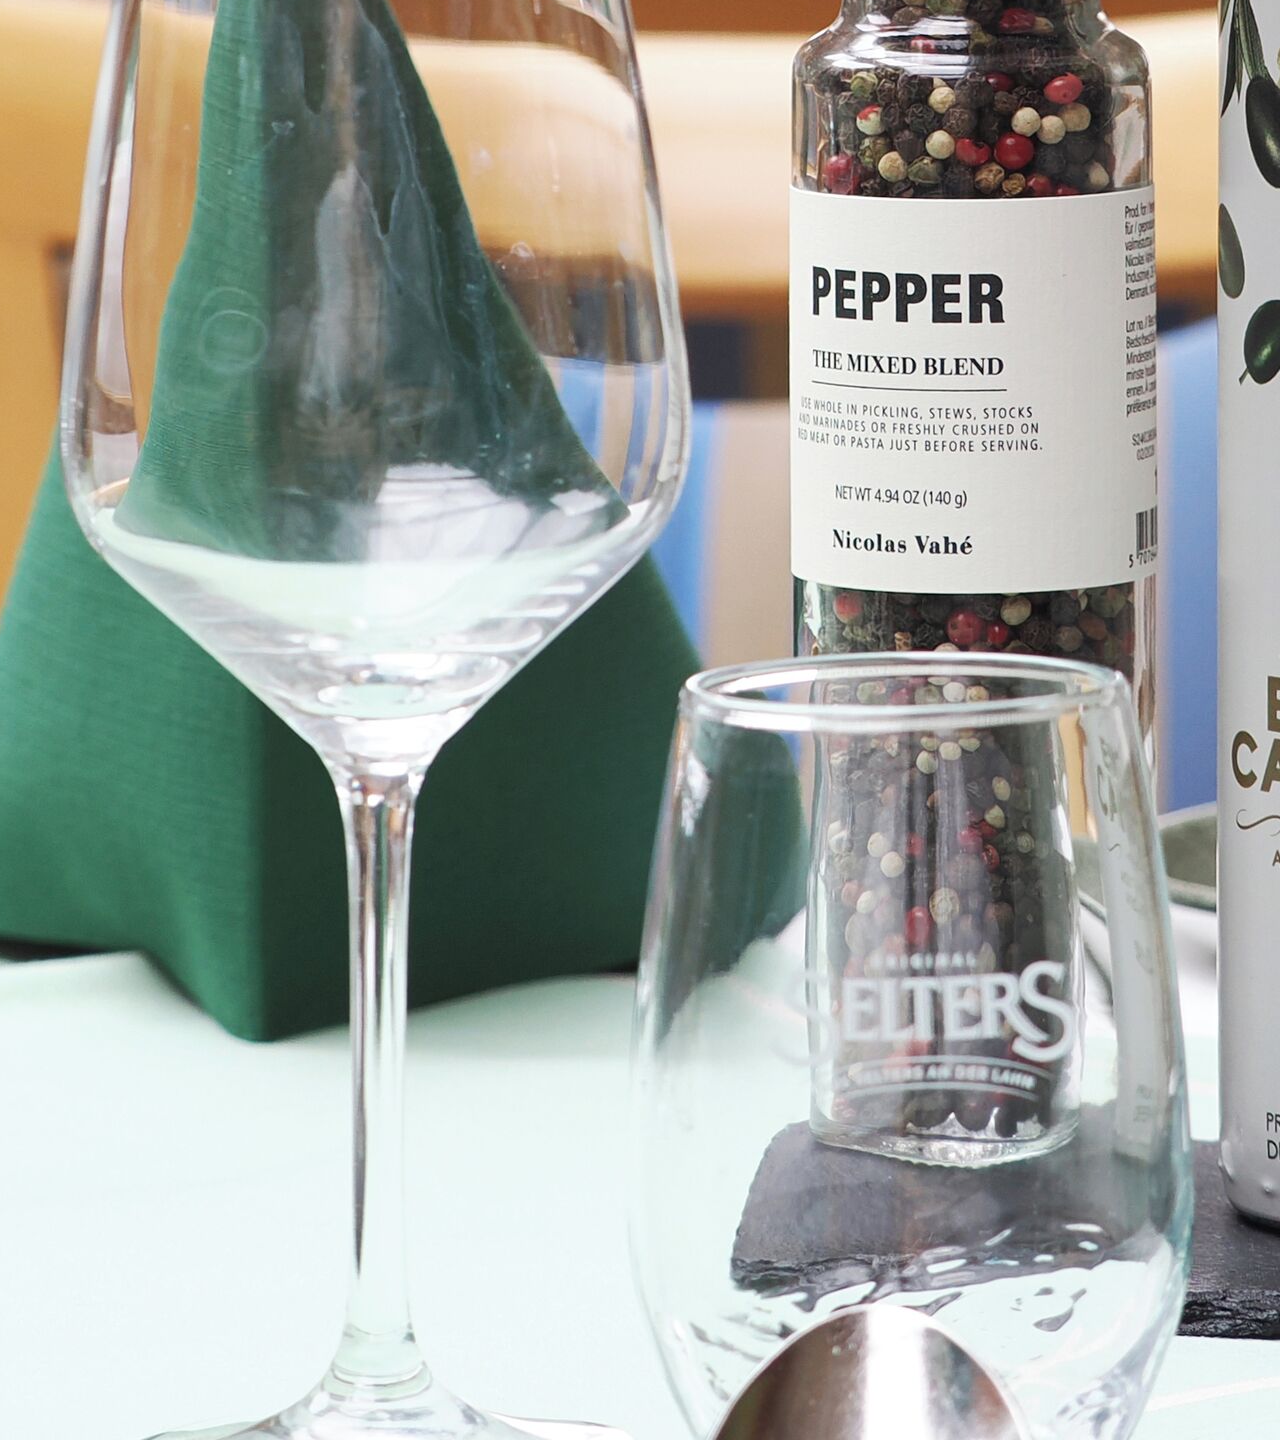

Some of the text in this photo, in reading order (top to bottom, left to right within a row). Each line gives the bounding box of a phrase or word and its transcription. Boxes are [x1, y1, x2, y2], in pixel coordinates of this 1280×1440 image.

[812, 265, 1006, 324] PEPPER
[813, 349, 1004, 375] THE MIXED BLEND
[814, 399, 842, 414] WHOLE
[846, 403, 857, 415] IN
[862, 404, 923, 420] PICKLING,
[929, 407, 976, 420] STEWS,
[983, 406, 1033, 419] STOCKS
[813, 415, 866, 432] MARINADES
[871, 421, 887, 433] OR
[892, 423, 945, 435] FRESHLY
[952, 423, 1015, 435] CRUSHED
[1021, 422, 1039, 434] ON
[810, 430, 830, 445] MEAT
[833, 434, 846, 447] OR
[850, 436, 884, 450] PASTA
[890, 439, 918, 451] JUST
[924, 440, 975, 452] BEFORE
[981, 439, 1043, 452] SERVING.
[835, 484, 968, 509] NET WT 4.94 OZ (140 g)
[832, 529, 973, 555] Nicolas Vahé
